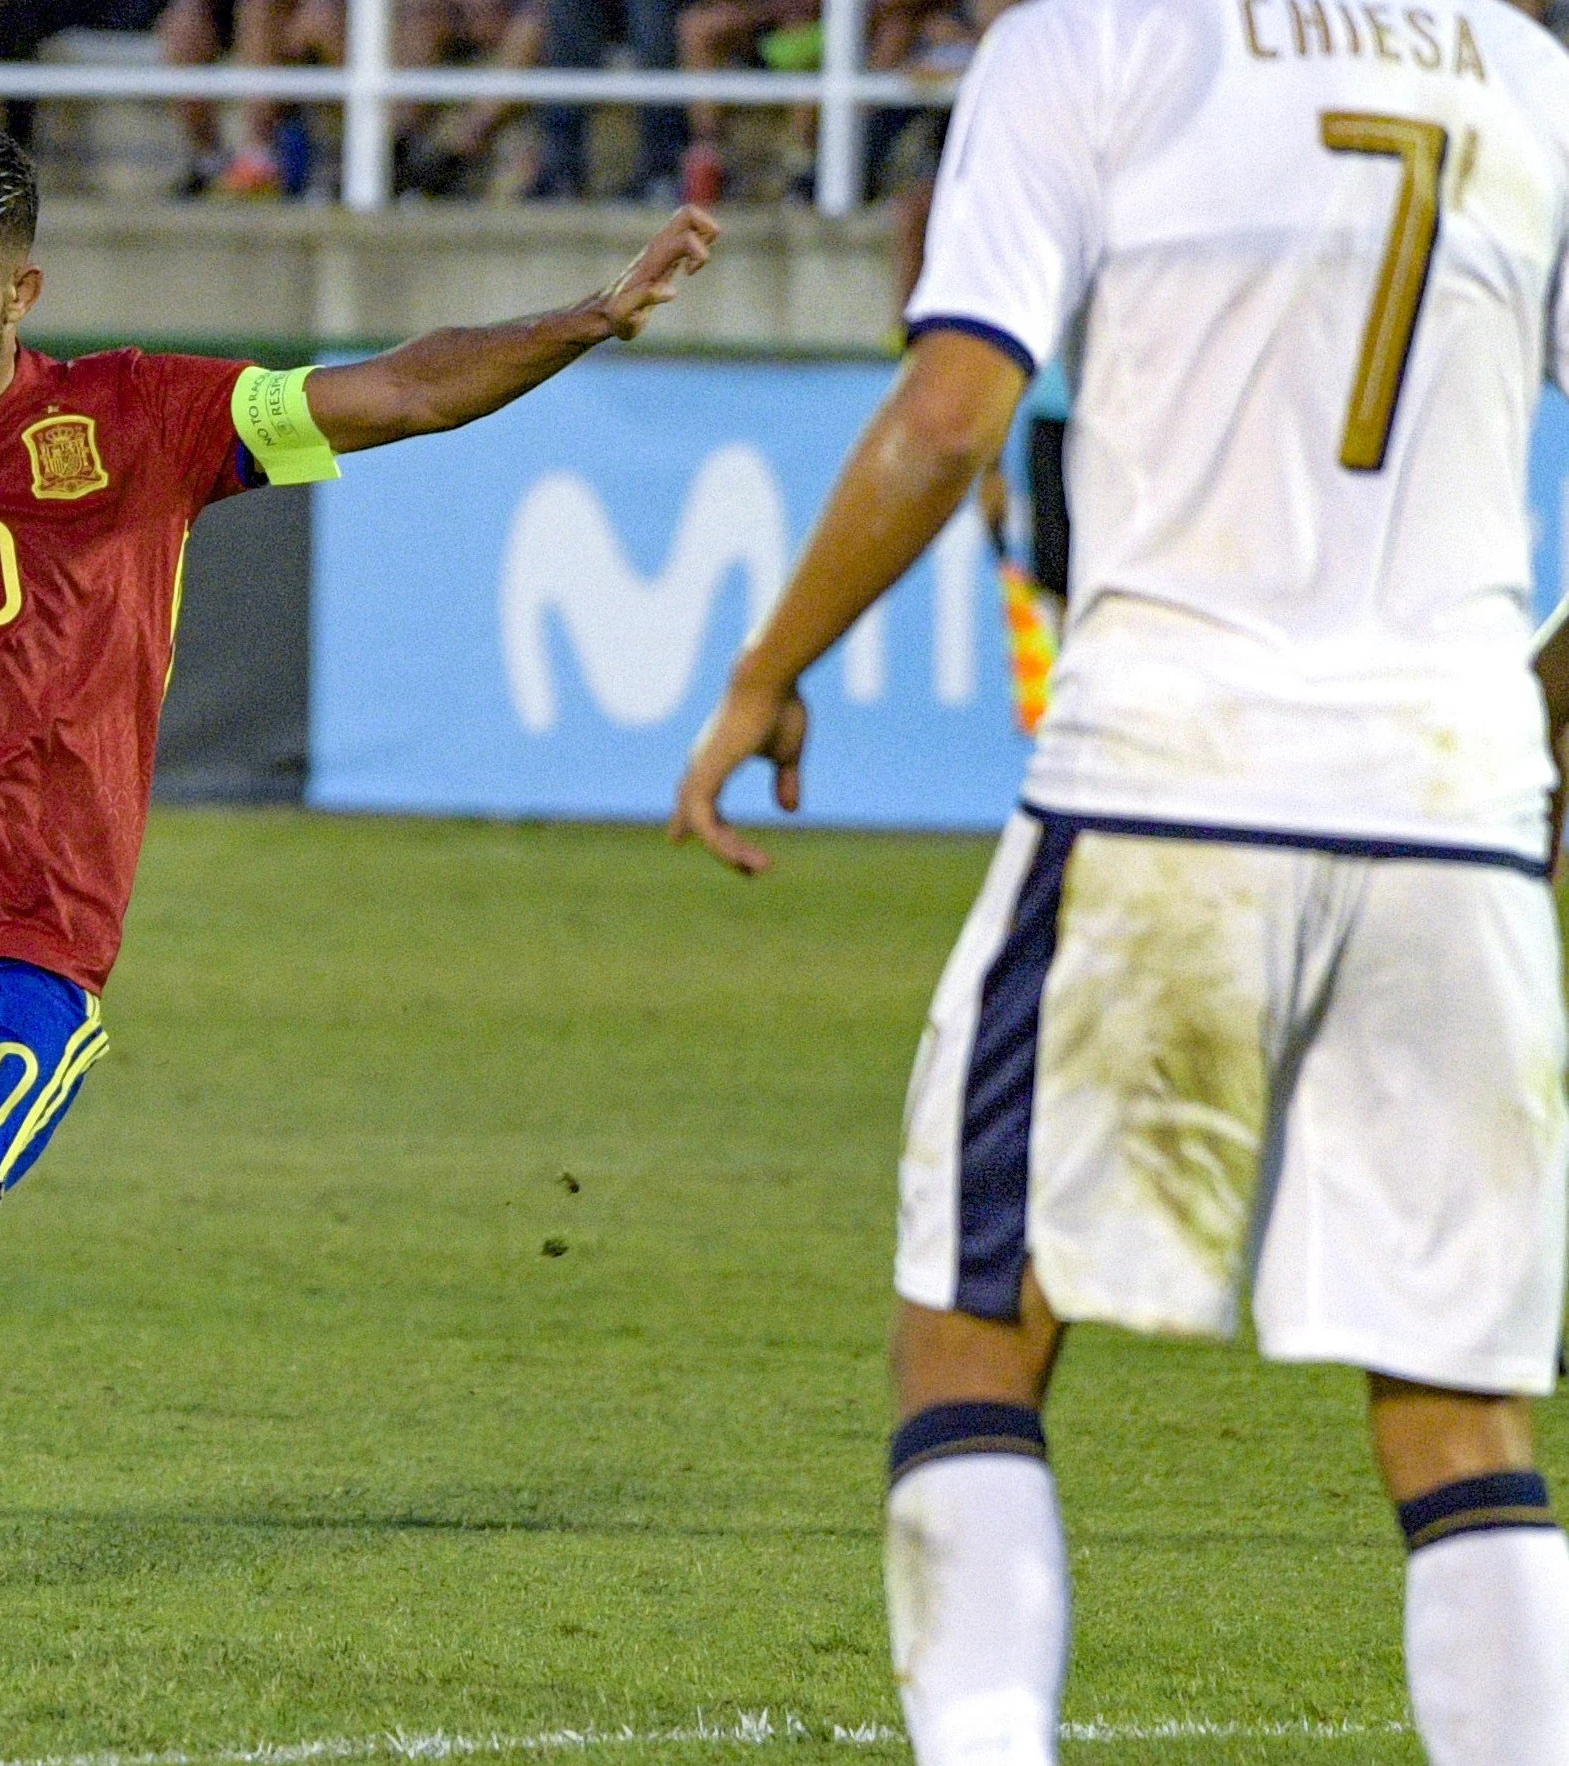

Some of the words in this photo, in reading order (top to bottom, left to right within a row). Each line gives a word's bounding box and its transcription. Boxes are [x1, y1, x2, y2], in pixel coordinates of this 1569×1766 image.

[1240, 0, 1487, 83] CHIESA
[1319, 111, 1447, 473] 7
[248, 405, 260, 426] TO
[257, 428, 276, 447] NO
